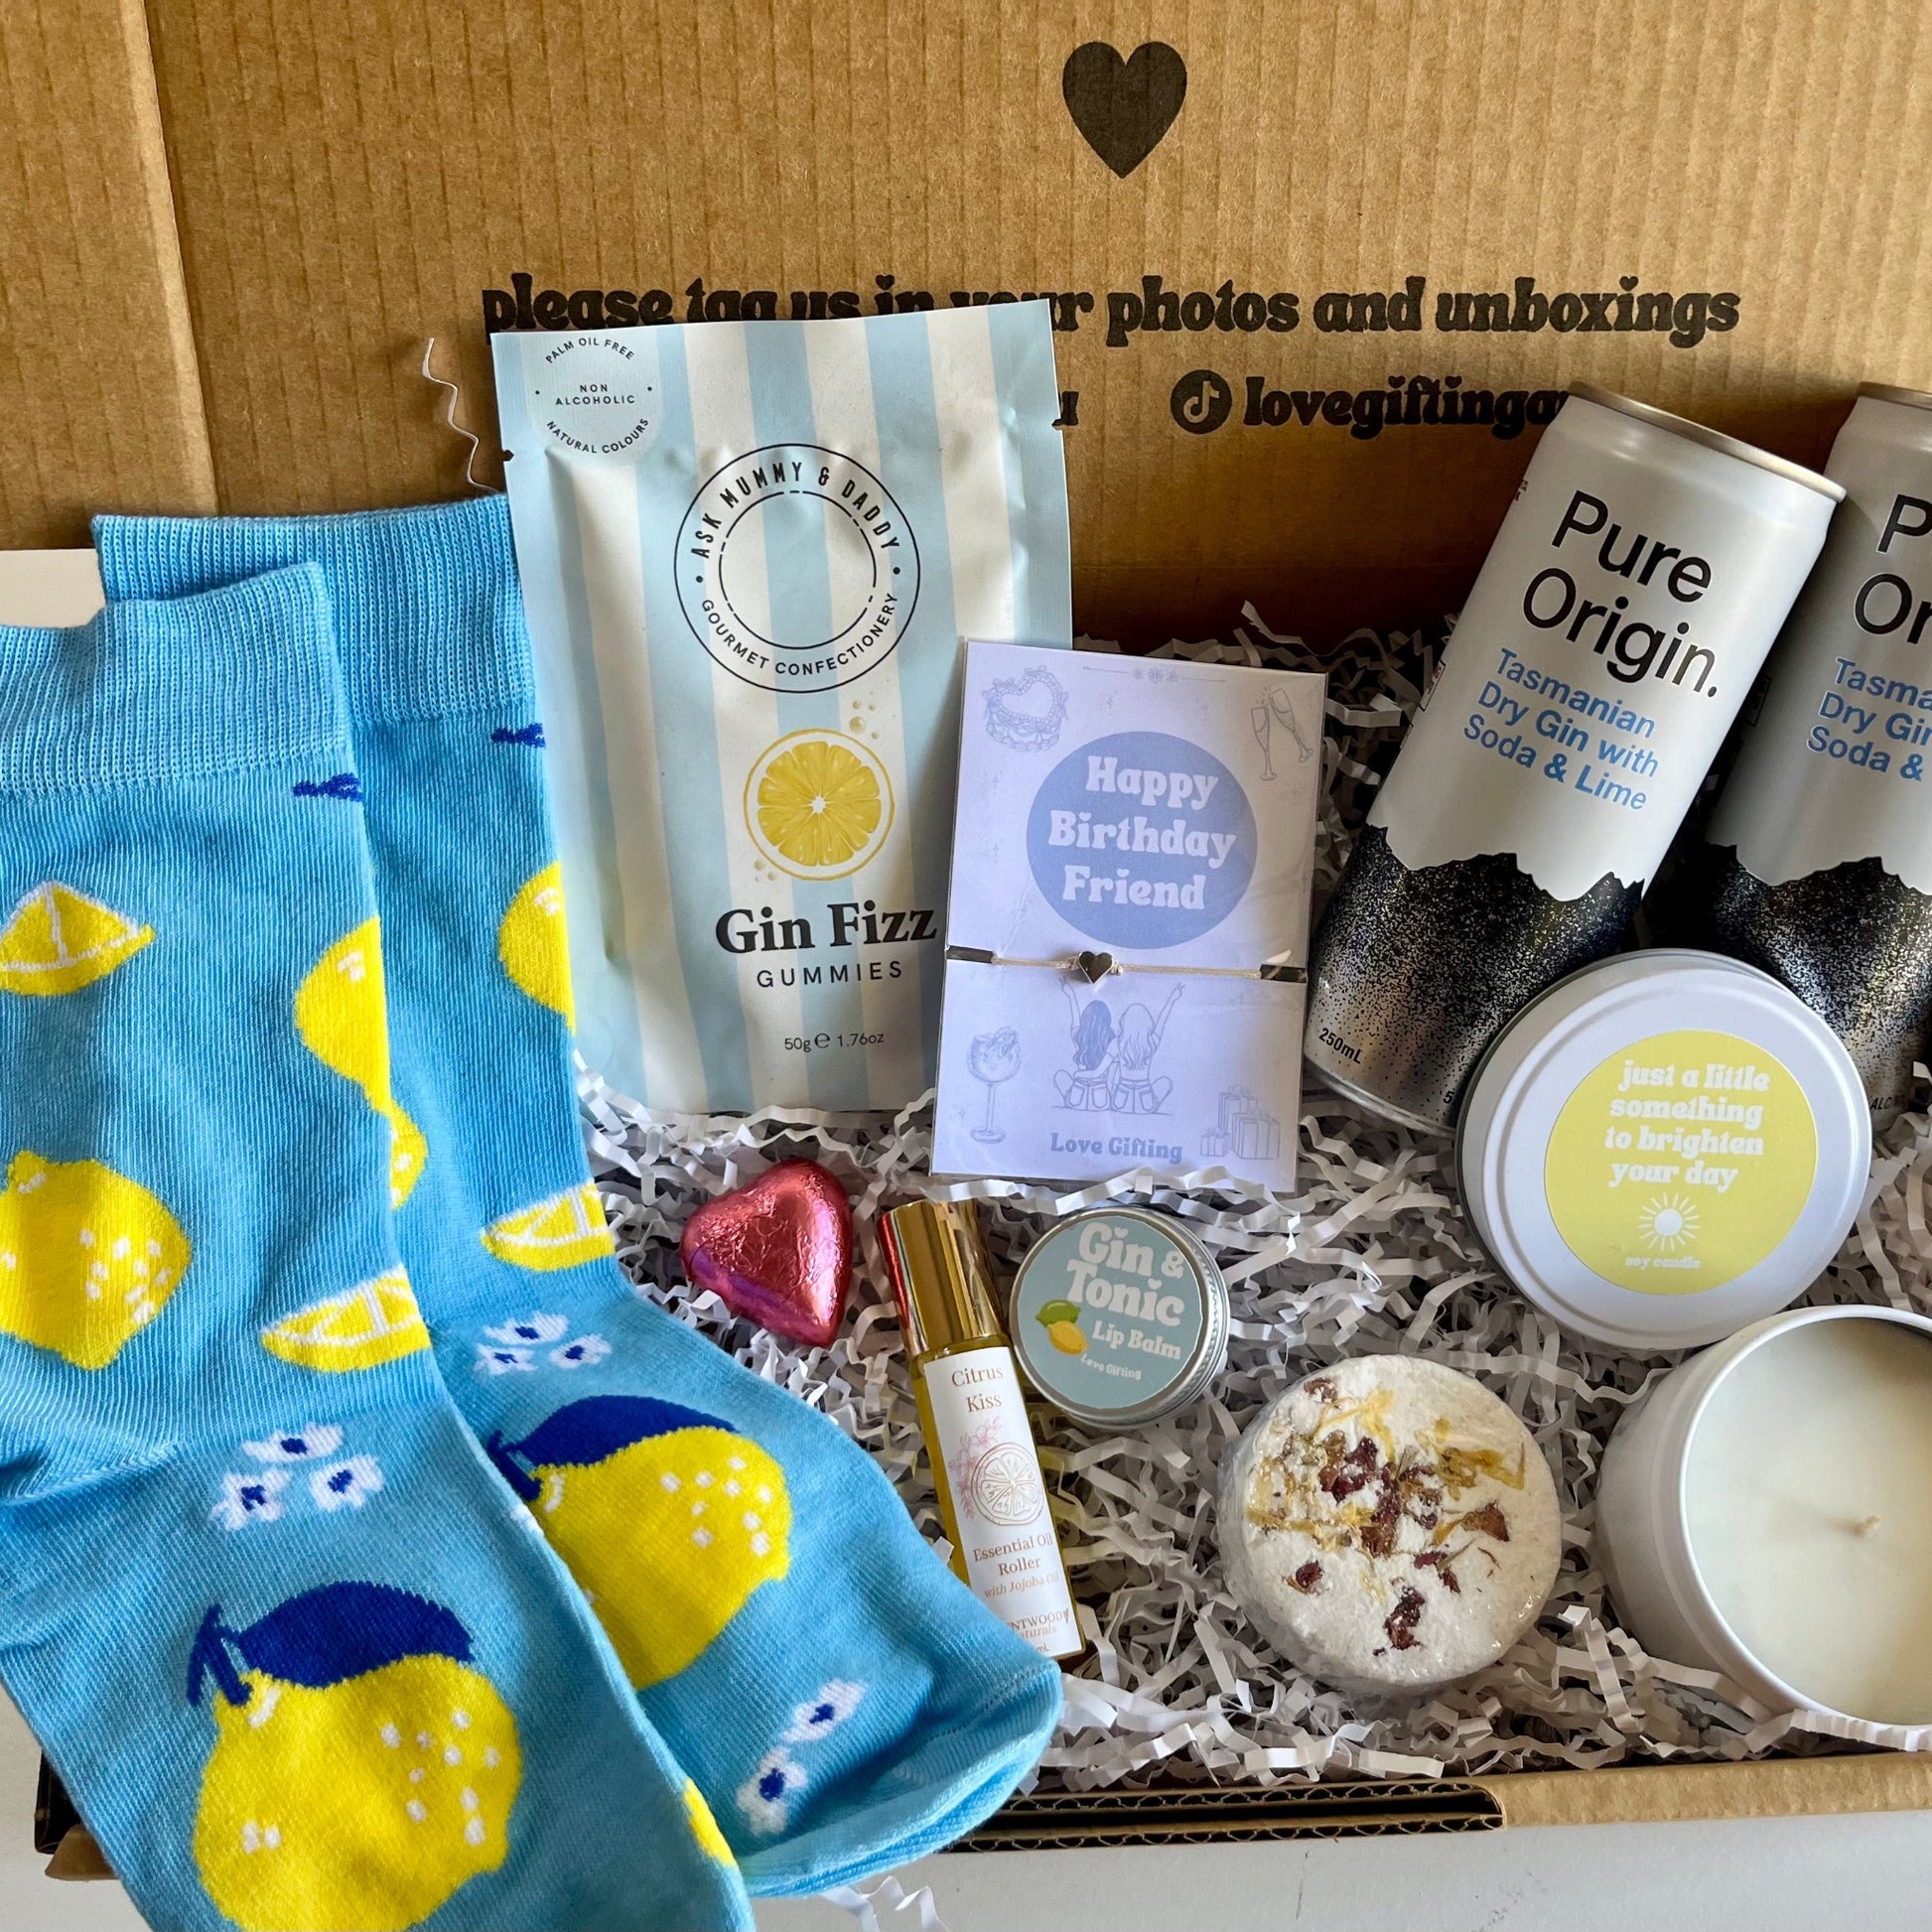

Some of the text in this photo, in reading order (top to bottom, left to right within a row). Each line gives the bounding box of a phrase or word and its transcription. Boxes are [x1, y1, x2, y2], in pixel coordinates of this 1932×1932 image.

[482, 273, 674, 344] please
[1106, 275, 1300, 347] photos
[1313, 273, 1427, 333] and
[1436, 275, 1741, 348] unboxings
[545, 337, 634, 363] PALM OIL FREE
[555, 394, 635, 406] ALCOHOLIC
[579, 383, 609, 393] NON
[1244, 374, 1570, 440] lovegiftinga
[546, 418, 649, 454] NATURAL COLOURS
[690, 462, 900, 559] ASK MUMMY & DADDY
[1551, 489, 1713, 604] Pure
[701, 593, 897, 676] GOURMET CONFECTIONERY
[1523, 567, 1718, 698] Origin.
[1493, 646, 1656, 740] Tasmanian
[1477, 680, 1530, 725] Dry
[1535, 709, 1589, 753] Gin
[1597, 739, 1659, 778] with
[1818, 691, 1876, 735] Dry
[1463, 713, 1647, 811] Soda & Lime
[1807, 725, 1924, 782] Soda &
[1086, 755, 1218, 810] Happy
[1048, 809, 1236, 869] Birthday
[1062, 865, 1206, 909] Friend
[715, 899, 938, 955] Gin Fizz
[757, 960, 901, 988] GUMMIES
[784, 1036, 812, 1053] 50g
[836, 1033, 885, 1048] 1.76oz
[1318, 1028, 1362, 1064] 250mL
[1618, 1059, 1770, 1091] just a little
[1609, 1095, 1763, 1130] something
[1050, 1132, 1183, 1164] Love Gifting
[1604, 1125, 1763, 1160] to brighten
[1608, 1160, 1738, 1193] your day
[1078, 1222, 1184, 1279] Gin &
[1066, 1259, 1185, 1326] Tonic
[1092, 1320, 1181, 1359] Lip Balm
[951, 1366, 1003, 1387] Citrus
[1080, 1353, 1142, 1380] Love Gifting
[967, 1393, 1002, 1413] Kiss
[973, 1532, 1053, 1562] Essential Oil
[999, 1556, 1041, 1577] Roller
[984, 1583, 1007, 1598] with
[1009, 1575, 1044, 1592] Jojoba
[1007, 1610, 1063, 1630] NTWOOD
